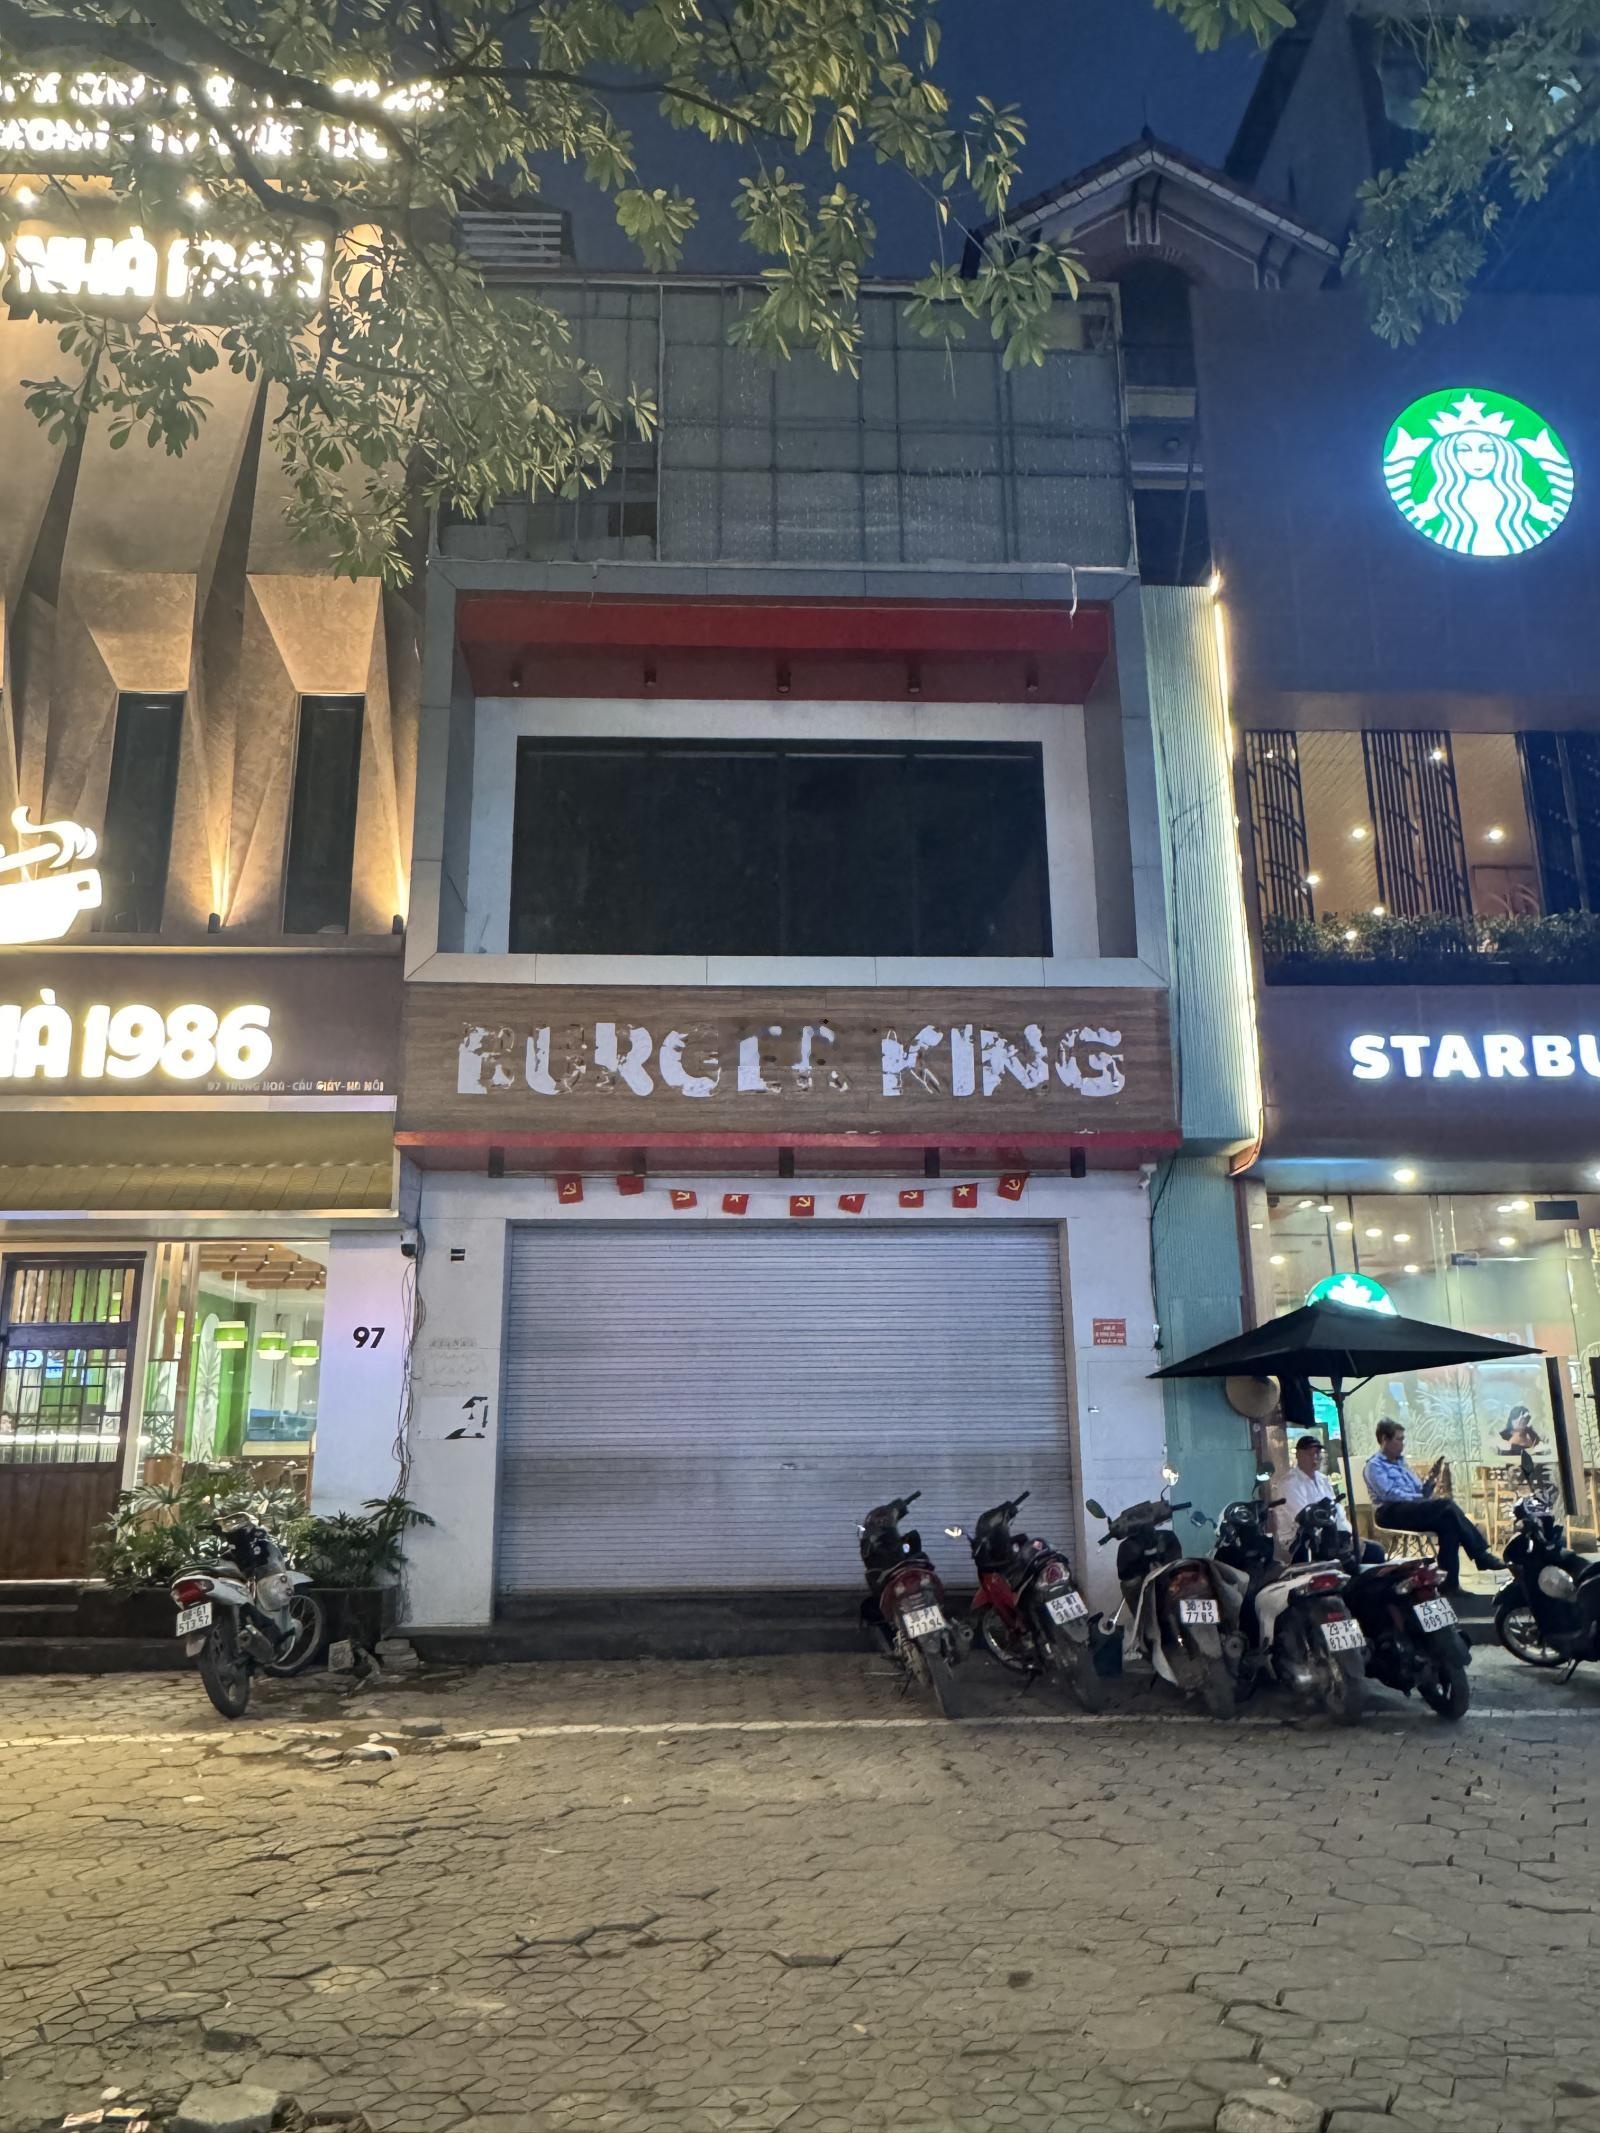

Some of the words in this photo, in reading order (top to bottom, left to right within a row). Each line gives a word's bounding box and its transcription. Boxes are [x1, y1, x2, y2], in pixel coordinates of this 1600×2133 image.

[81, 1003, 273, 1080] 1986
[881, 1023, 1126, 1097] KING
[353, 1326, 385, 1348] 97
